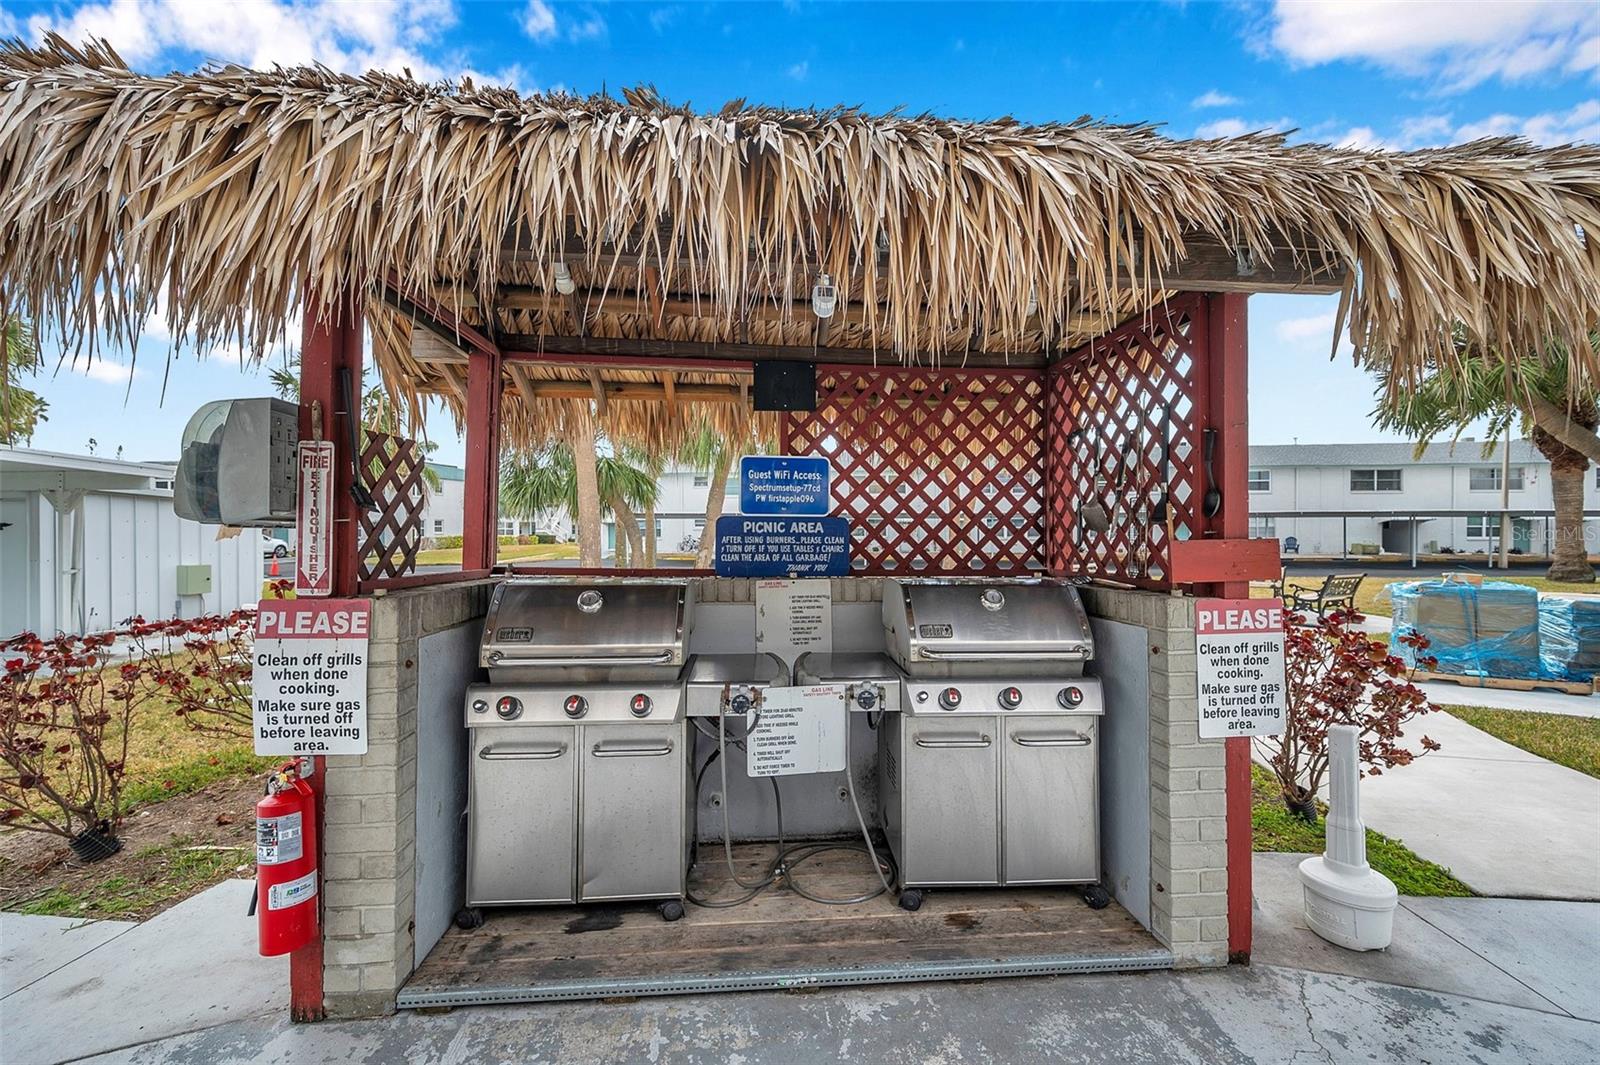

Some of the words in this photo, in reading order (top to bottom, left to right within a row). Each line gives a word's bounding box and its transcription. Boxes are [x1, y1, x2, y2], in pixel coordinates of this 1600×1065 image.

[302, 454, 329, 468] FIRE
[748, 470, 772, 480] Guest
[774, 470, 790, 480] WiFi
[792, 470, 822, 480] Access:
[749, 483, 820, 494] Spectrumsetup-77cd
[755, 494, 766, 502] PW
[768, 494, 814, 504] firstapple096
[309, 471, 320, 581] EXTINGUISHER
[743, 522, 786, 534] PICNIC
[790, 522, 824, 533] AREA
[721, 536, 742, 544] AFTER
[744, 536, 764, 544] USING
[796, 553, 831, 562] GARBAGE!
[786, 564, 812, 572] THANK
[813, 564, 828, 572] YOU
[258, 611, 368, 634] PLEASE
[1199, 608, 1281, 630] PLEASE
[1200, 644, 1230, 655] Clean
[1234, 642, 1248, 654] off
[1252, 642, 1279, 655] grills
[258, 654, 298, 666] Clean
[303, 654, 323, 666] off
[327, 653, 362, 668] grills
[1210, 656, 1240, 666] when
[1243, 655, 1269, 666] done
[270, 668, 309, 680] when
[314, 668, 348, 680] done
[1217, 668, 1264, 680] cooking.
[279, 682, 340, 696] cooking.
[1202, 684, 1230, 695] Make
[1233, 685, 1258, 694] sure
[1261, 683, 1280, 696] gas
[1208, 696, 1217, 706] is
[1221, 694, 1256, 706] turned
[1260, 693, 1274, 704] off
[258, 700, 295, 712] Make
[300, 702, 331, 711] sure
[336, 700, 360, 713] gas
[1203, 707, 1238, 719] before
[1241, 706, 1280, 719] leaving
[266, 714, 278, 725] is
[283, 712, 330, 725] turned
[334, 712, 353, 724] off
[1228, 720, 1256, 730] area.
[260, 727, 306, 738] before
[310, 726, 360, 740] leaving
[294, 741, 329, 751] area.
